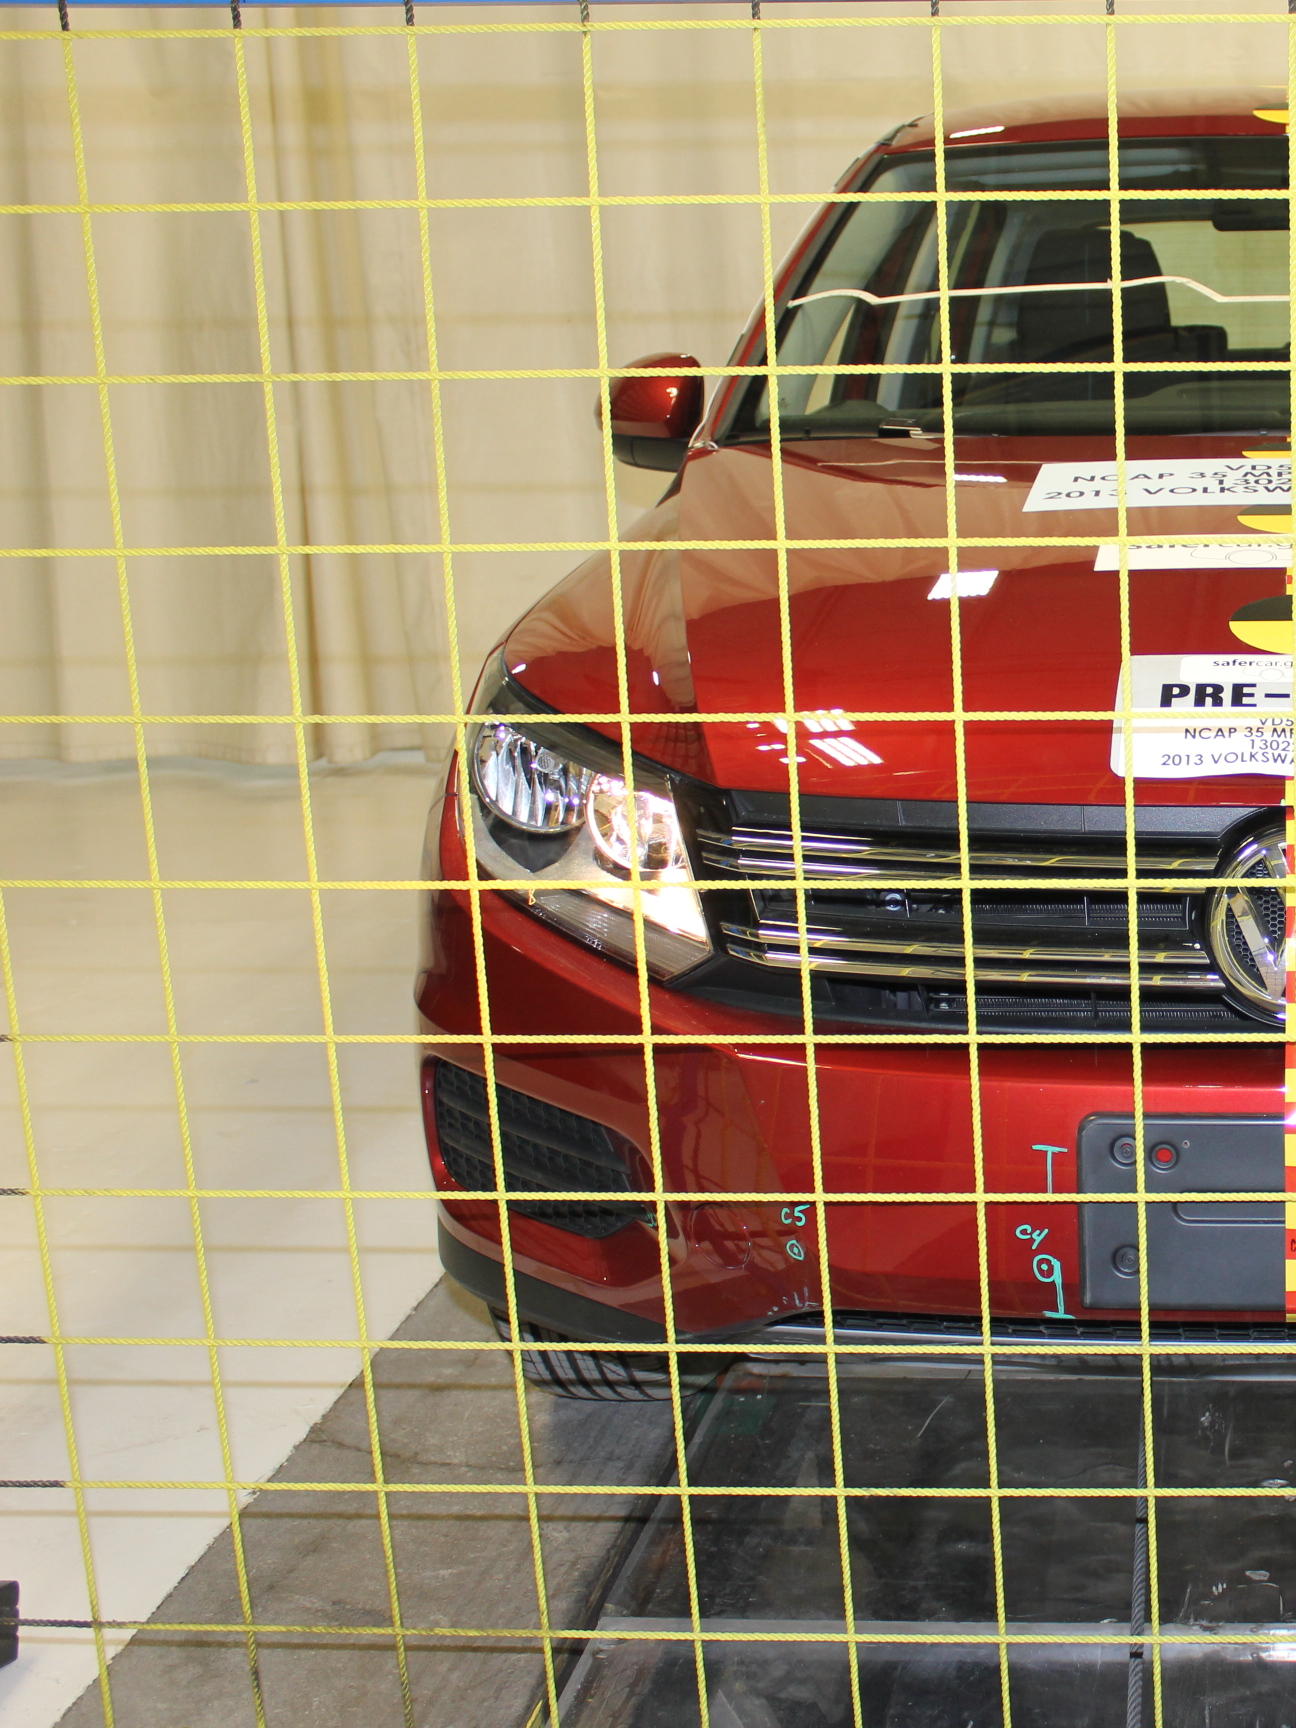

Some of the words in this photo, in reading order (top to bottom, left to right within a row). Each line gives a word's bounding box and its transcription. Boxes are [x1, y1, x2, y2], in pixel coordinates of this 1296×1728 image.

[1072, 472, 1175, 483] NCAP
[1187, 471, 1229, 479] 35
[1042, 489, 1127, 500] 2013
[1184, 727, 1238, 740] NCAP
[1243, 726, 1265, 738] 35
[1160, 753, 1204, 766] 2013
